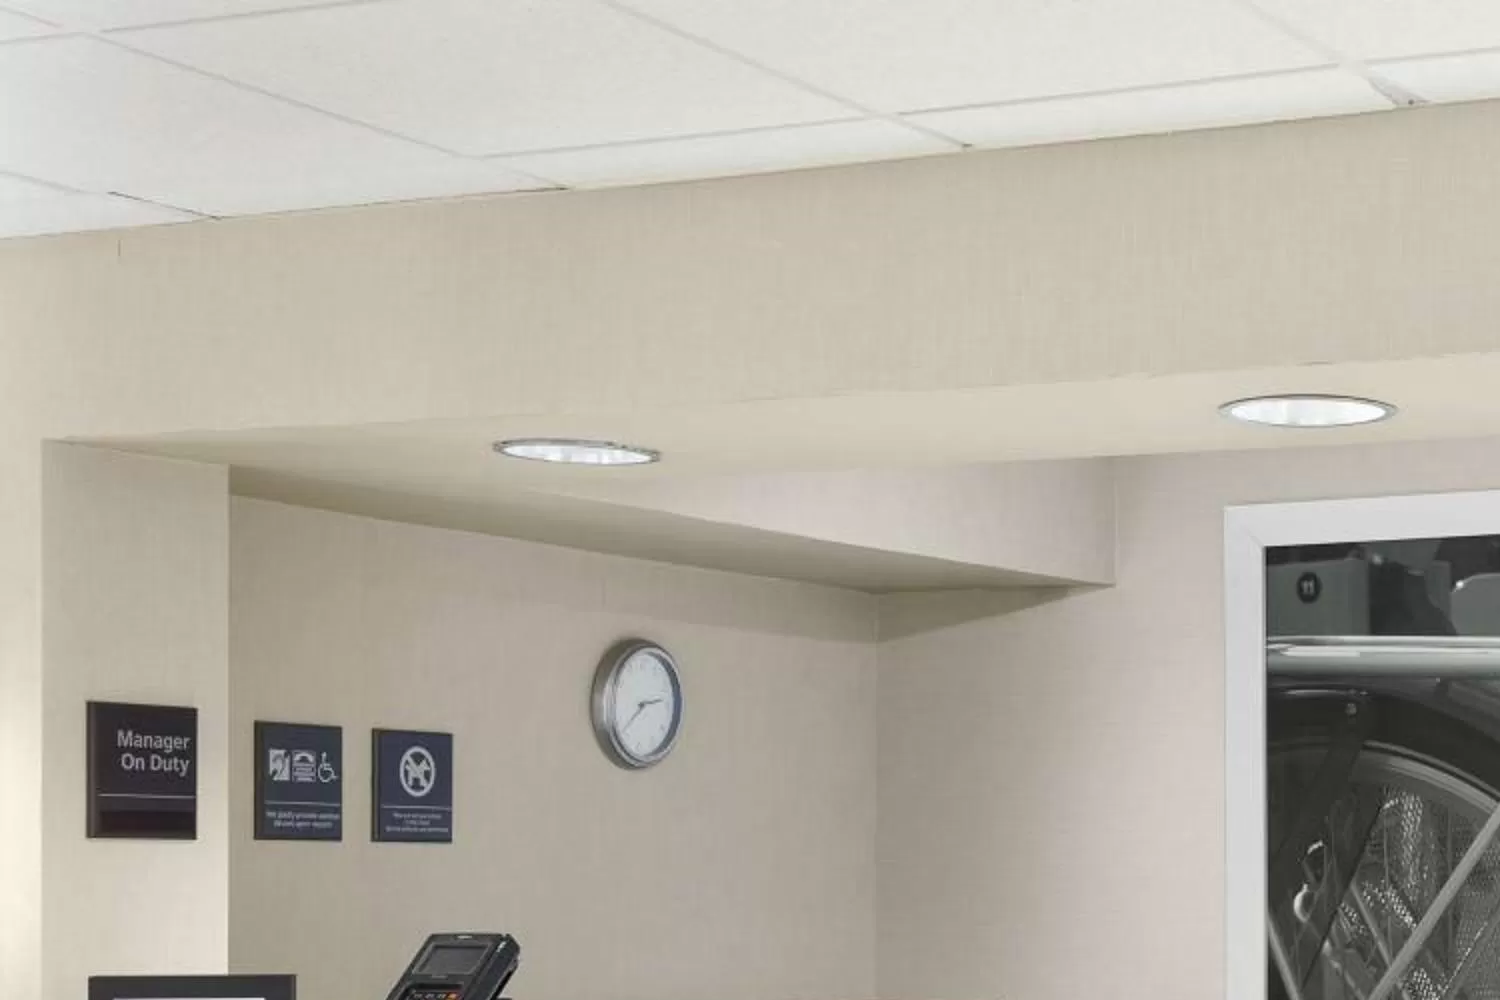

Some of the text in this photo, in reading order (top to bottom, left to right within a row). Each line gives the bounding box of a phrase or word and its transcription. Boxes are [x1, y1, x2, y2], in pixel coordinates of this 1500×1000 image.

[117, 729, 191, 752] Manager
[121, 753, 190, 777] On Duty
